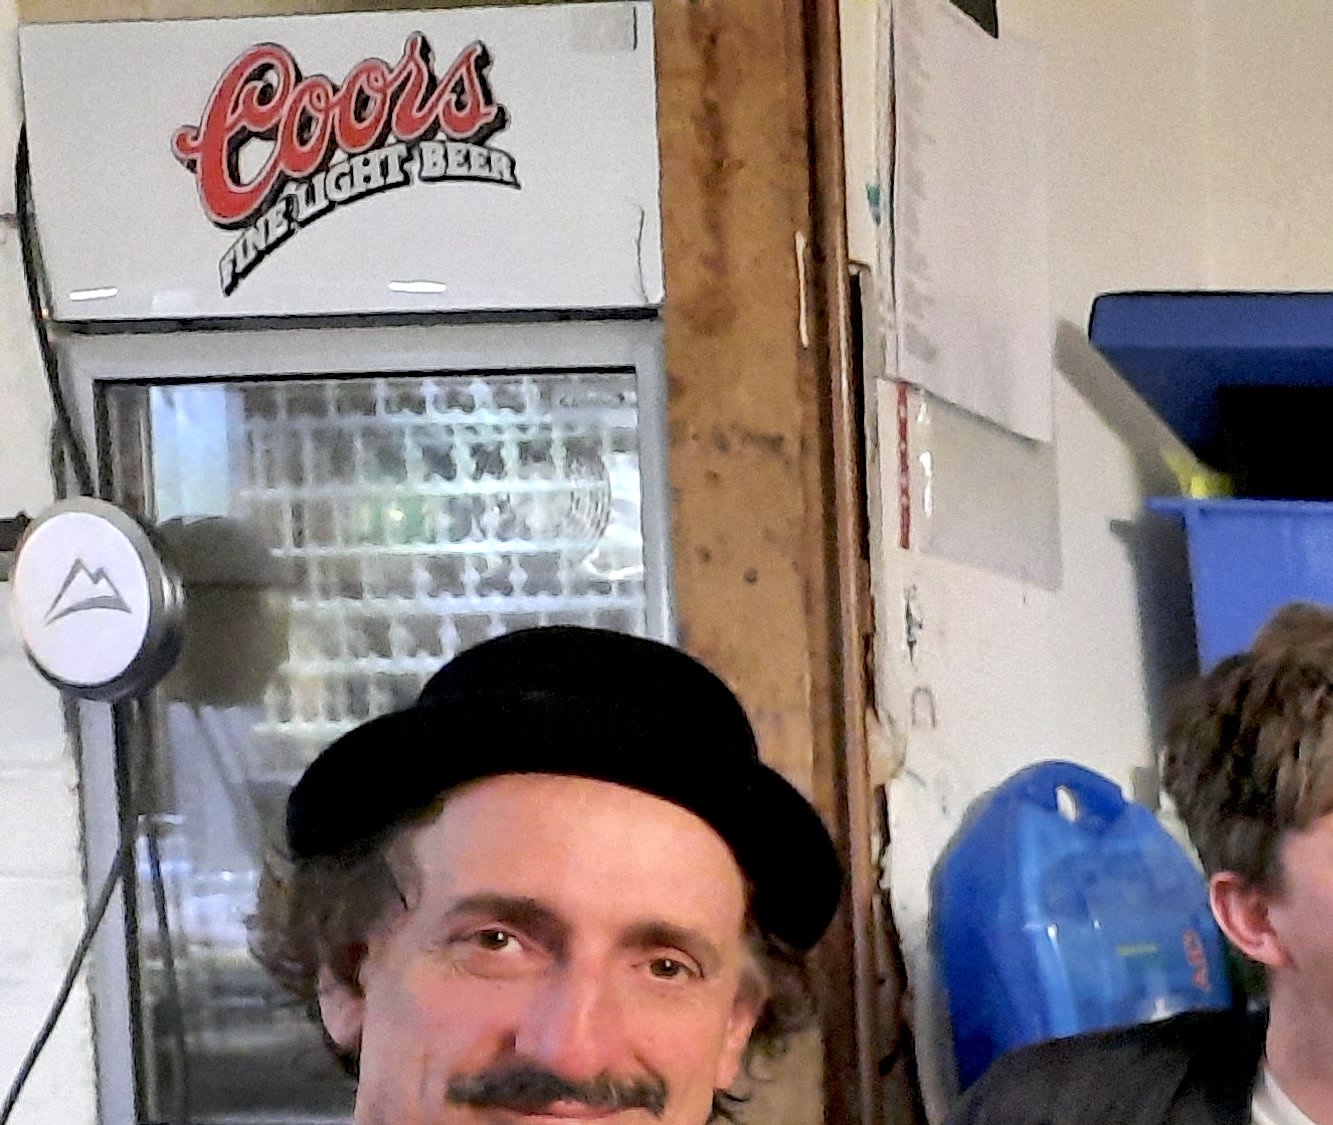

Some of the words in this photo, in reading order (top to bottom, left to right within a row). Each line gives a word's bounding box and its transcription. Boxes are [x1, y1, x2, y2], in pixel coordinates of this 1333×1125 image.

[171, 31, 511, 230] Coors
[219, 197, 299, 296] FINE
[288, 145, 412, 226] LIGHT
[418, 140, 520, 189] BEER
